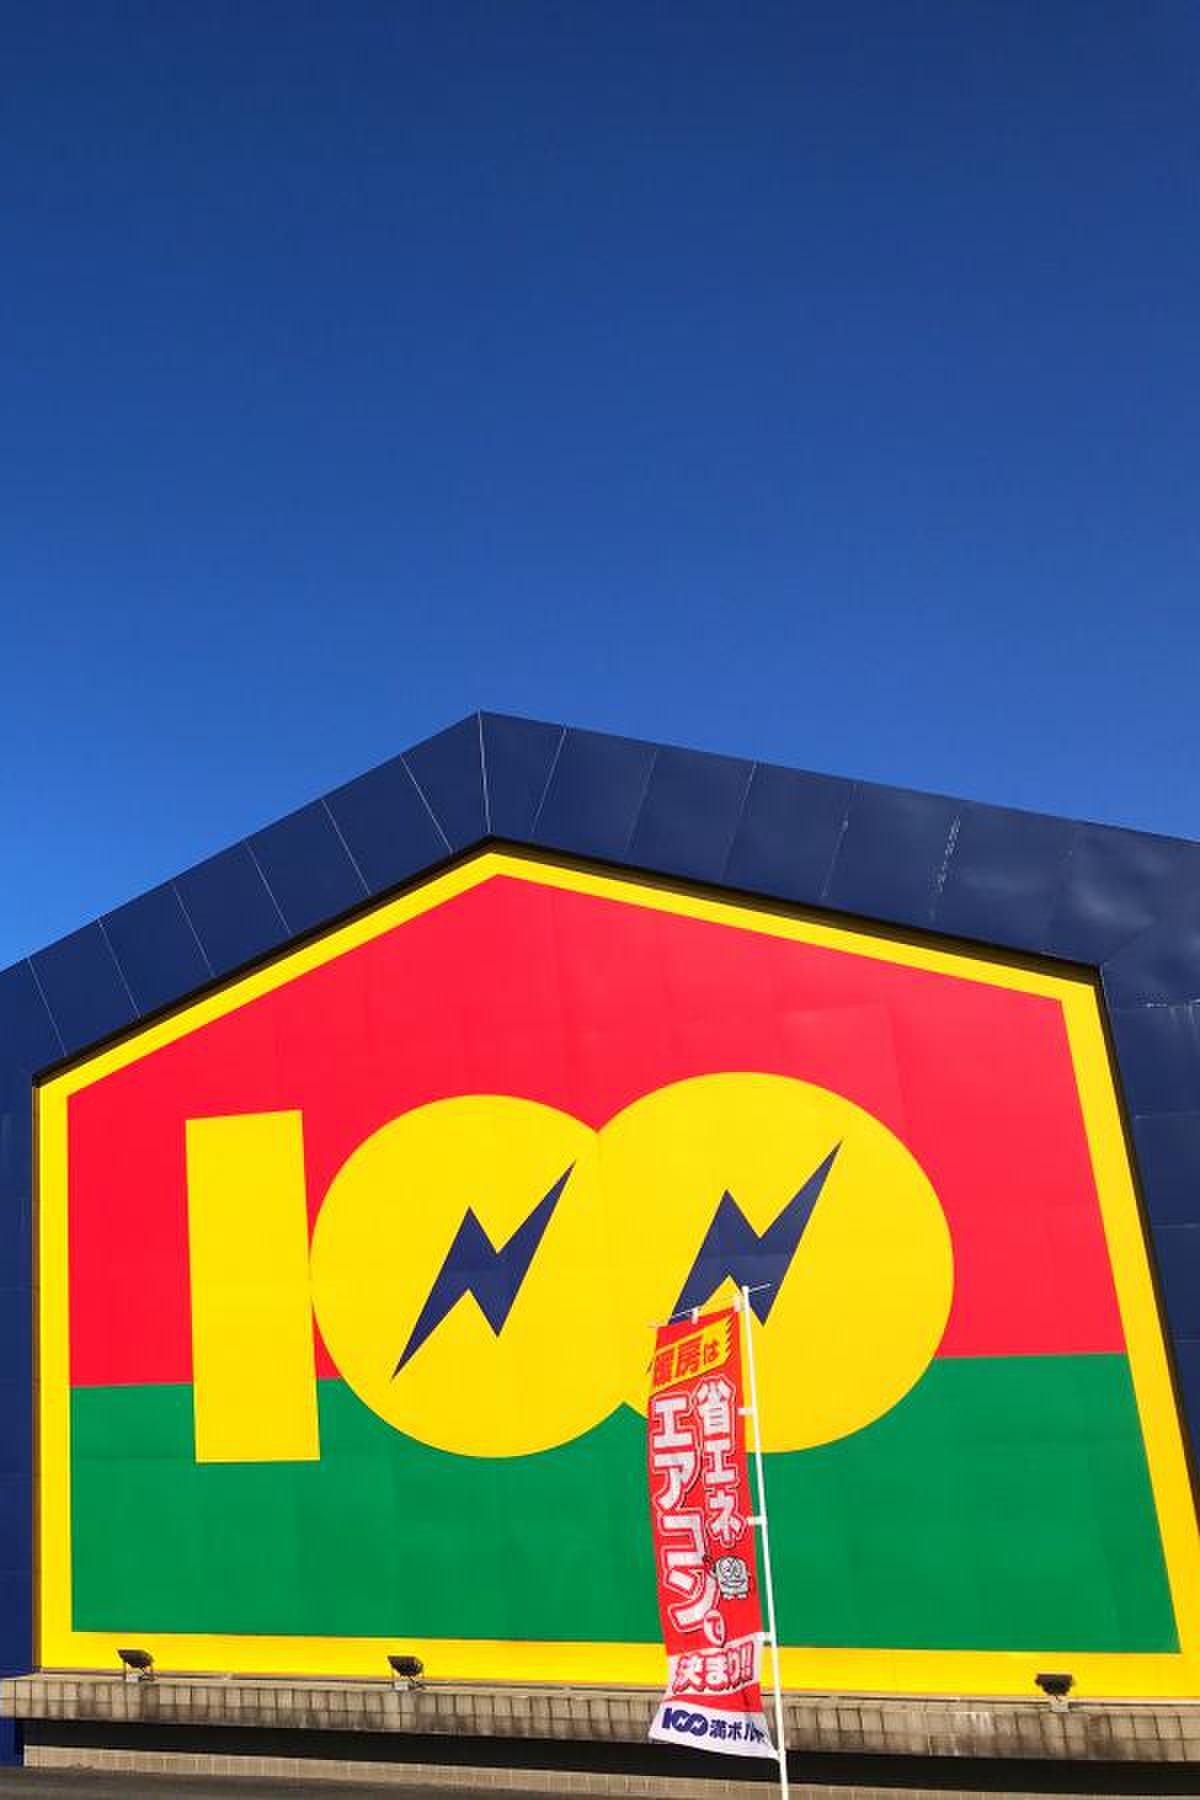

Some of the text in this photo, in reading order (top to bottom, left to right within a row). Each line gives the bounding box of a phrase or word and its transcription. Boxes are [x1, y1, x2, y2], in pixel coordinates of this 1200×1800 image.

[185, 1071, 954, 1464] 100
[651, 1332, 718, 1387] 暖房は
[652, 1396, 725, 1645] エアコンで
[701, 1379, 742, 1542] 省エネ
